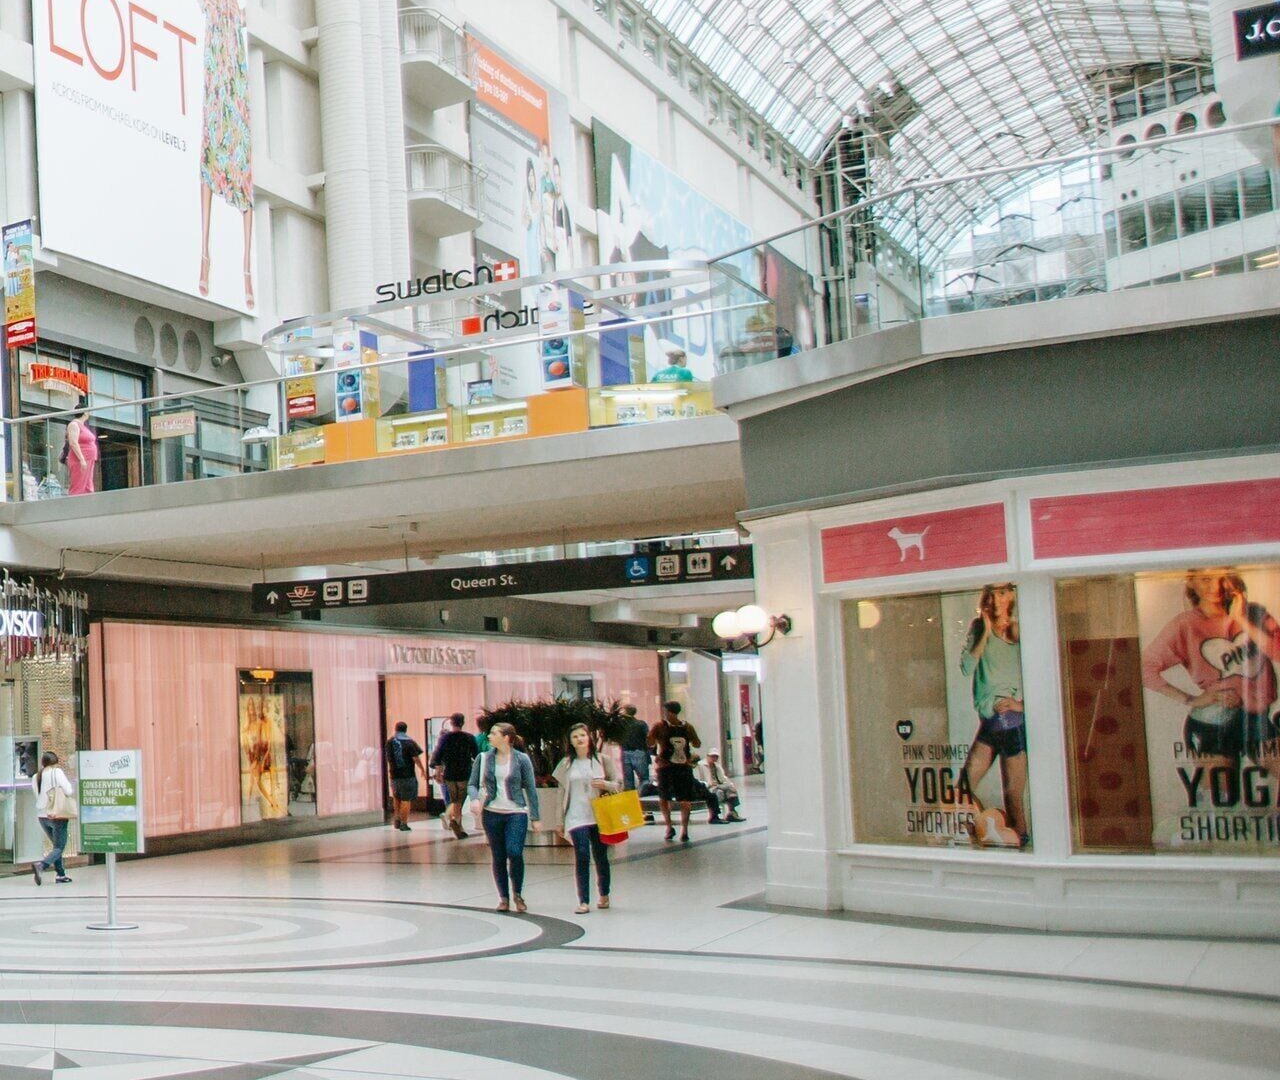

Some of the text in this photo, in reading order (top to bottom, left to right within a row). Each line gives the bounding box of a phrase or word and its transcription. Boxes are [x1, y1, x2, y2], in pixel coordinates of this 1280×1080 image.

[162, 129, 181, 150] LEVEL
[376, 265, 494, 304] swatch
[450, 574, 518, 591] Queen St.
[903, 743, 970, 761] PINK SUMMER
[82, 780, 127, 789] CONSERVING
[82, 788, 134, 797] ENERGY HELPS
[904, 766, 974, 805] YOGA
[1176, 766, 1280, 808] YOG
[906, 810, 975, 835] SHORTIES
